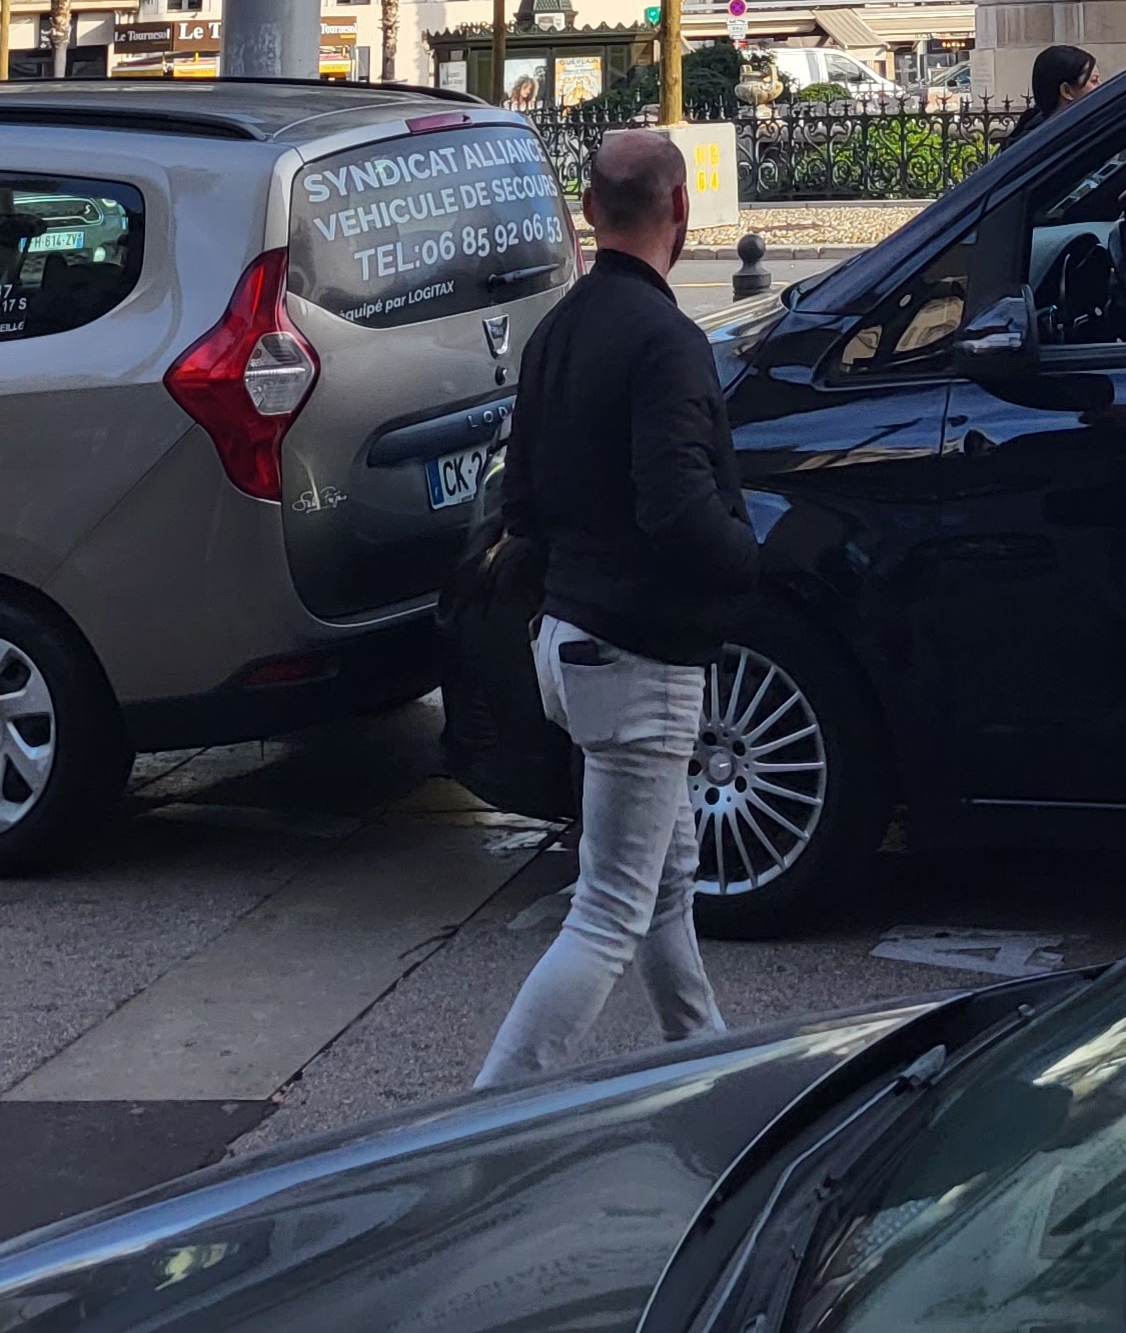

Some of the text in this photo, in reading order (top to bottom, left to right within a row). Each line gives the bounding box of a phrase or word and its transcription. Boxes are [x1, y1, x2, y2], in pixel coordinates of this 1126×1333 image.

[114, 28, 170, 42] Le Tournesol
[178, 22, 204, 40] Le
[303, 137, 546, 202] SYNDICAT ALLIANCE
[313, 174, 558, 242] VEHICULE DE SECOURS
[354, 213, 563, 281] TEL:06 85 92 06 53
[0, 284, 13, 299] 7
[385, 295, 406, 313] par
[408, 280, 455, 304] LOGITAX
[0, 320, 25, 332] EILLE
[468, 406, 508, 427] LOD
